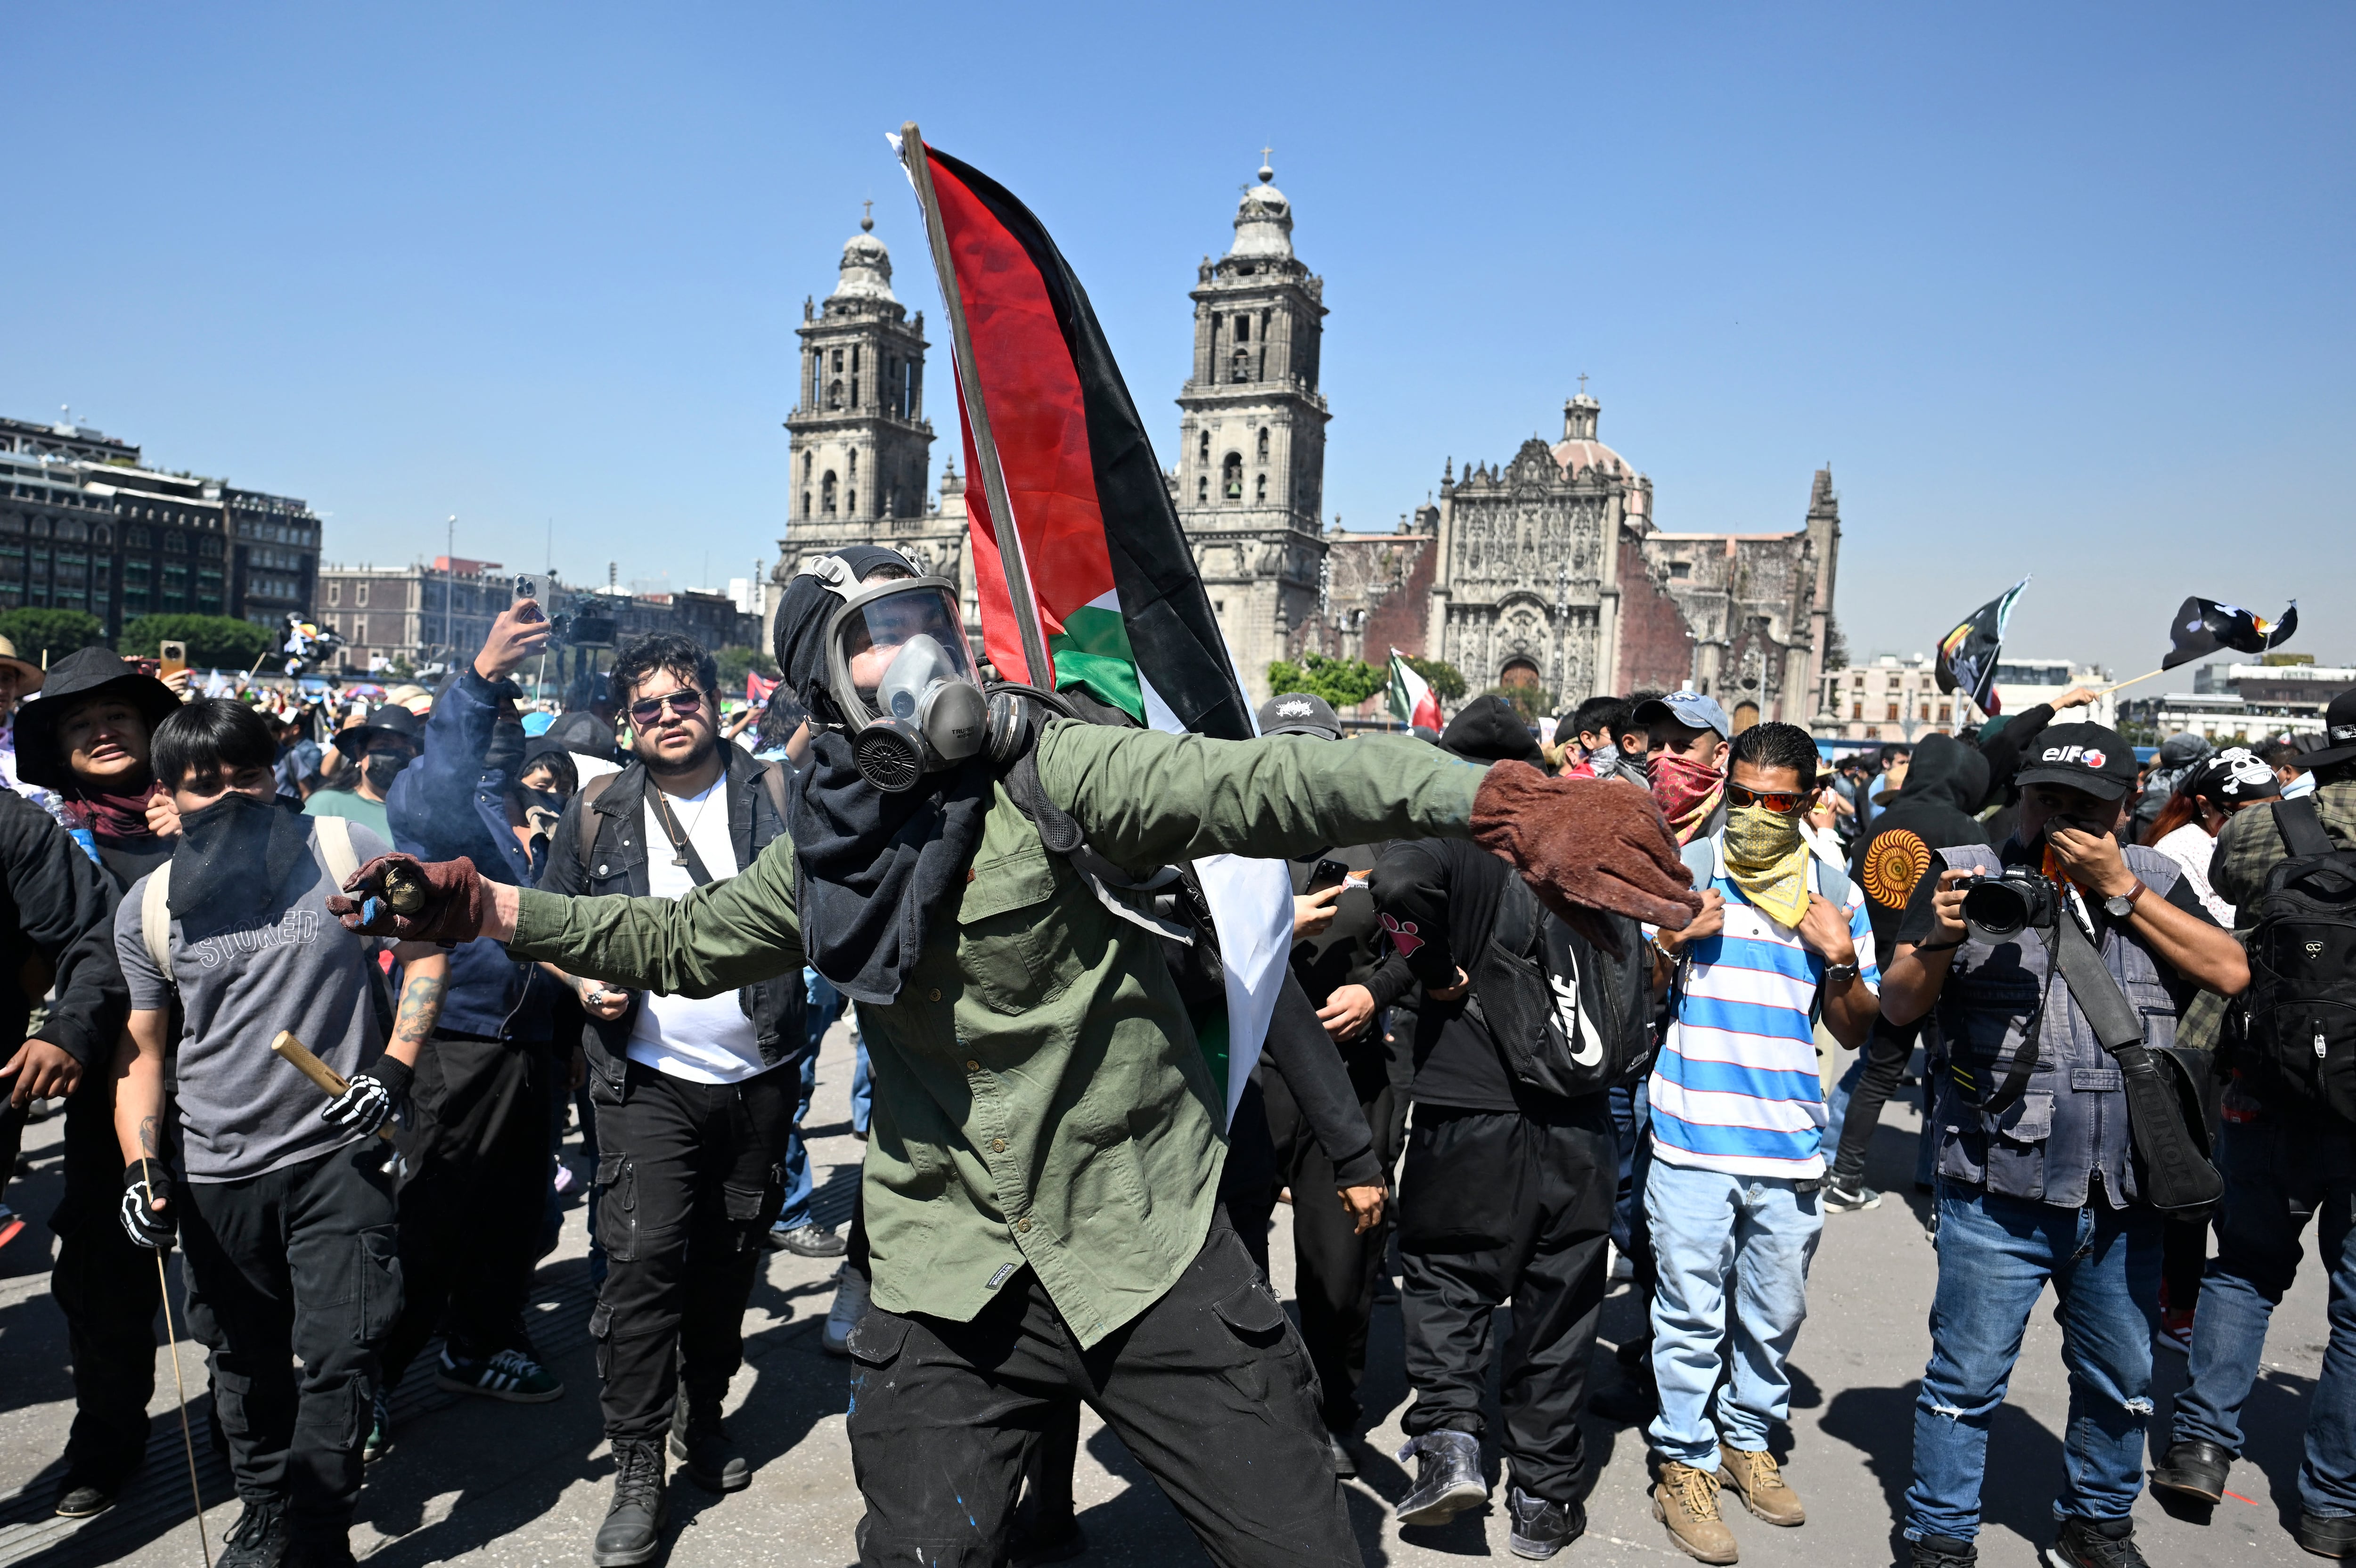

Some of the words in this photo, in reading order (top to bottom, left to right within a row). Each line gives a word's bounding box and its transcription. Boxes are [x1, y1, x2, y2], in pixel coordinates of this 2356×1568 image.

[952, 726, 974, 734] TRUPER
[193, 910, 319, 968] STOKED
[992, 1264, 1012, 1285] OUTDOOR
